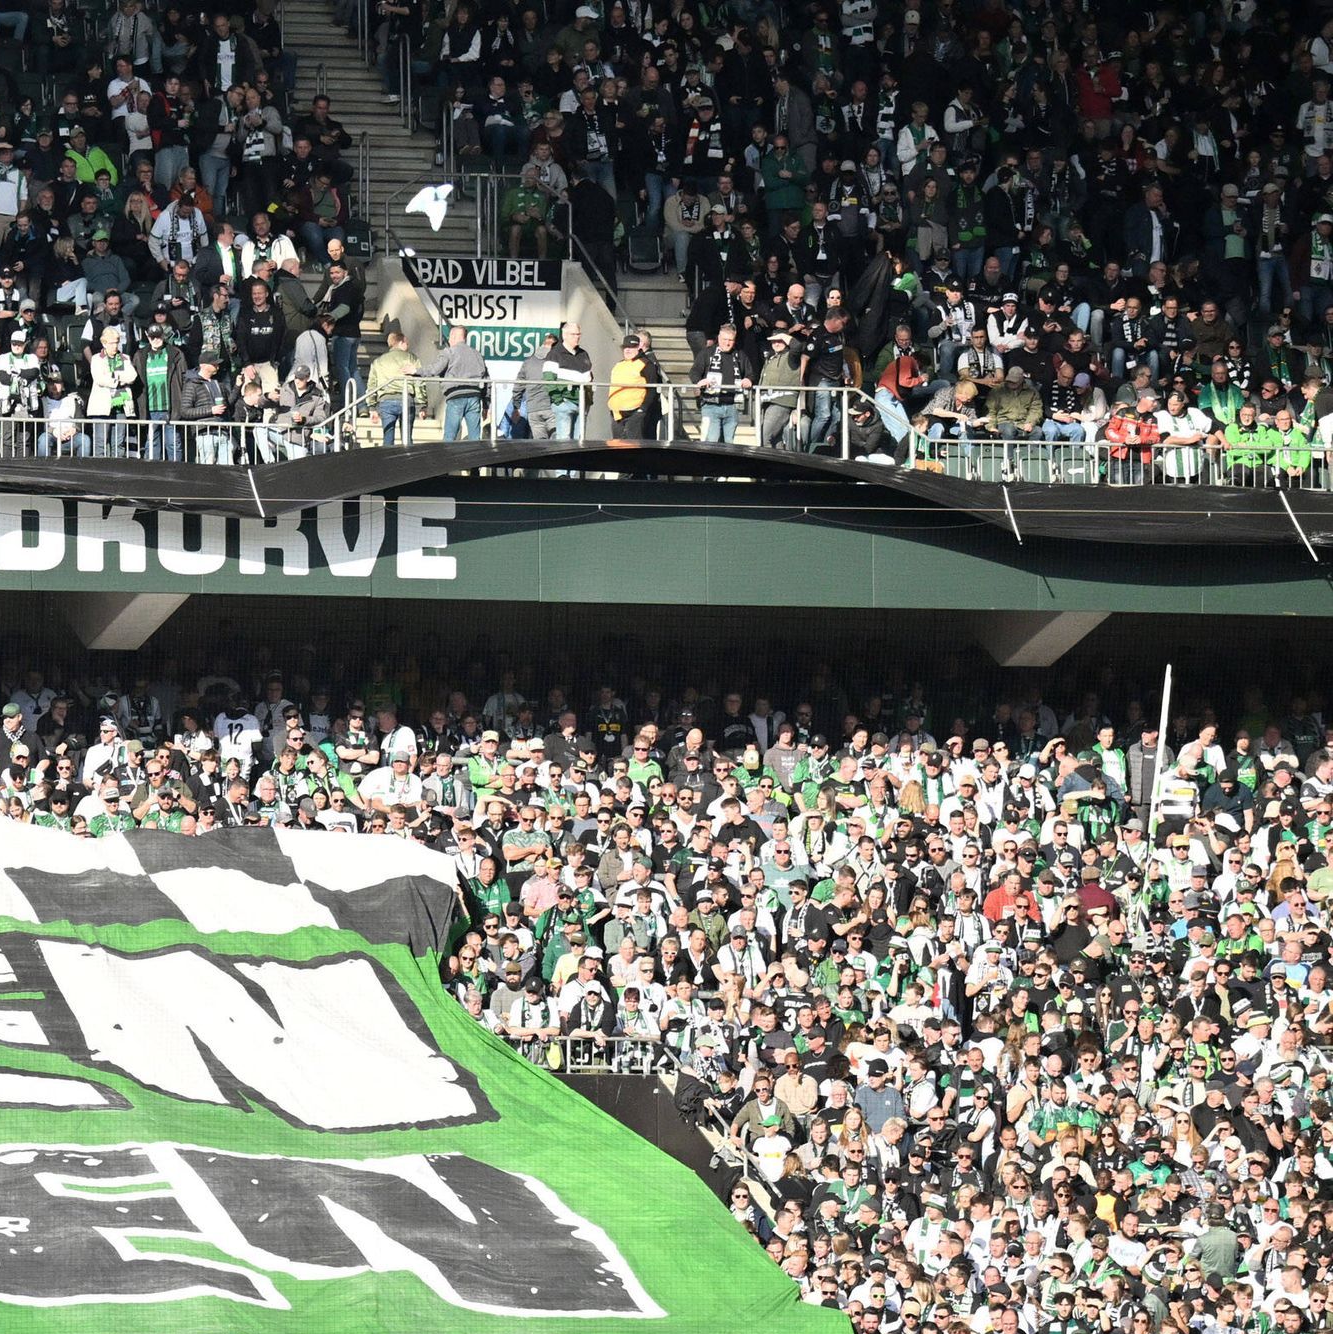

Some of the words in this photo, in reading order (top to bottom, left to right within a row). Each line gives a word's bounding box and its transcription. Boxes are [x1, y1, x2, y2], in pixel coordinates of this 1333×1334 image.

[417, 258, 463, 285] BAD
[472, 260, 546, 287] VILBEL
[439, 293, 522, 321] GRÜSST
[467, 330, 553, 357] ORUSSI
[227, 722, 244, 746] 12
